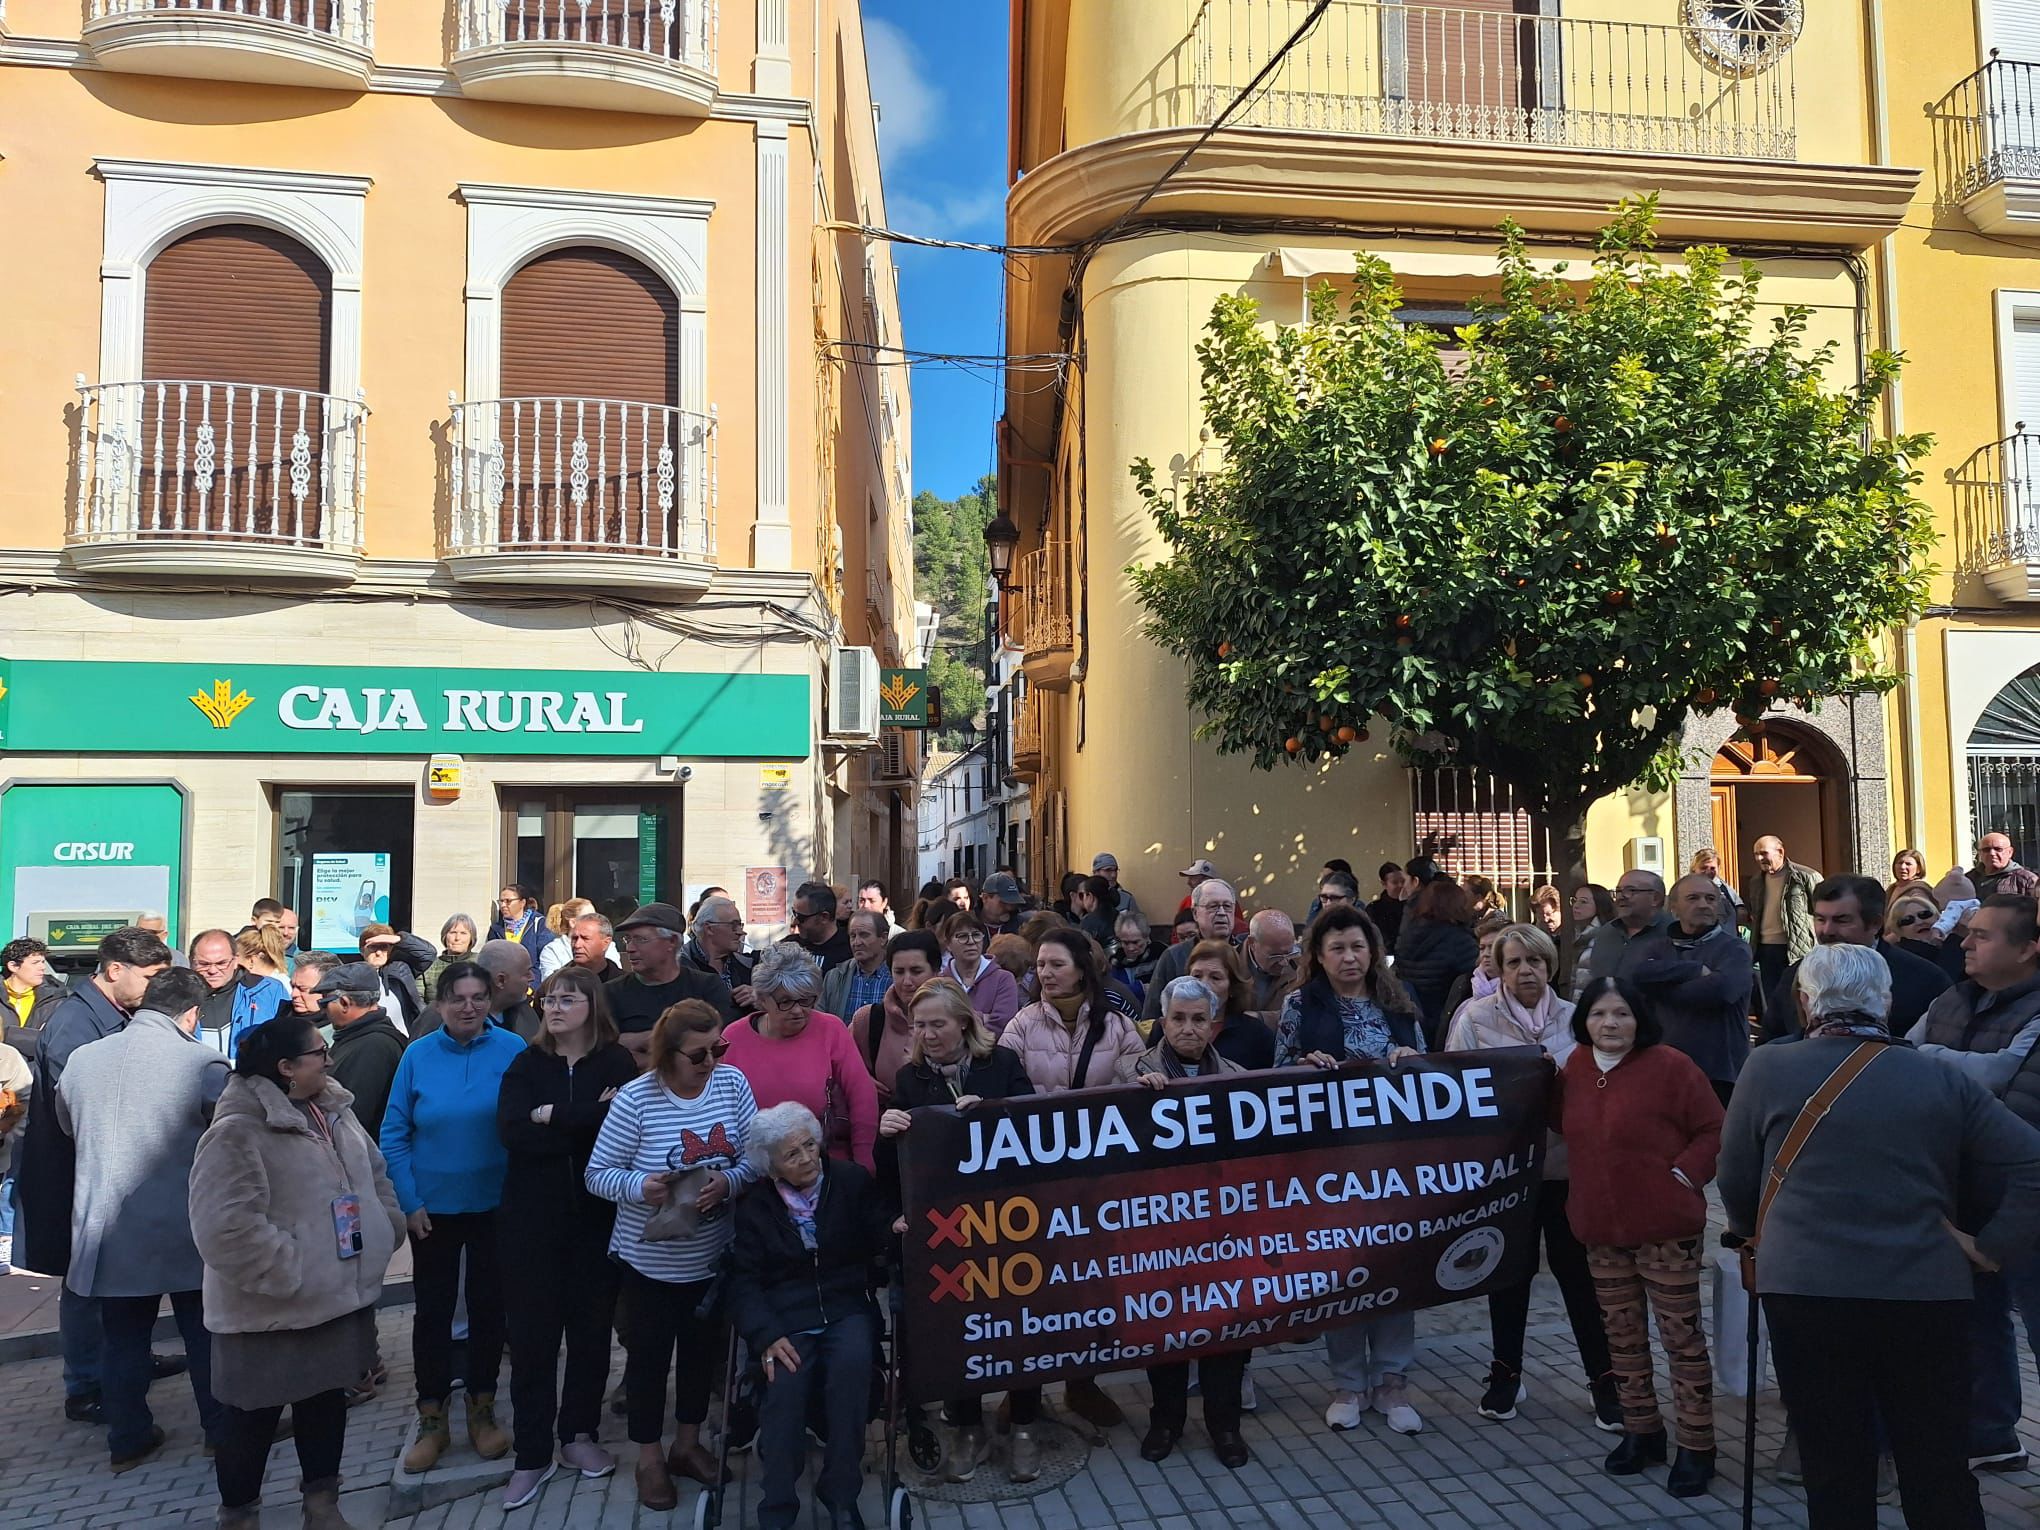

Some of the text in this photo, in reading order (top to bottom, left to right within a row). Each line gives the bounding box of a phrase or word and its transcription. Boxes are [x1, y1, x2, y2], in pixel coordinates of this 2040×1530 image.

[278, 685, 644, 735] CAJA RURAL
[54, 842, 134, 861] CRSUR
[957, 1067, 1498, 1174] JAUJA SE DEFIENDE
[960, 1196, 1040, 1248] NO
[1046, 1205, 1090, 1239] AL
[1097, 1188, 1211, 1232] CIERRE
[1219, 1182, 1258, 1216] DE
[1266, 1176, 1311, 1209] LA
[1315, 1167, 1413, 1204] CAJA
[1415, 1153, 1519, 1196] RURAL
[963, 1252, 1043, 1302] NO
[1049, 1263, 1067, 1285] A
[1072, 1261, 1103, 1282] LA
[1107, 1233, 1253, 1277] ELIMINACIÓN
[1259, 1232, 1300, 1256] DEL
[1305, 1221, 1413, 1251] SERVICIO
[963, 1266, 1370, 1341] Sin banco NO HAY PUEBLO
[964, 1287, 1399, 1380] Sin servicios NO HAY FUTURO
